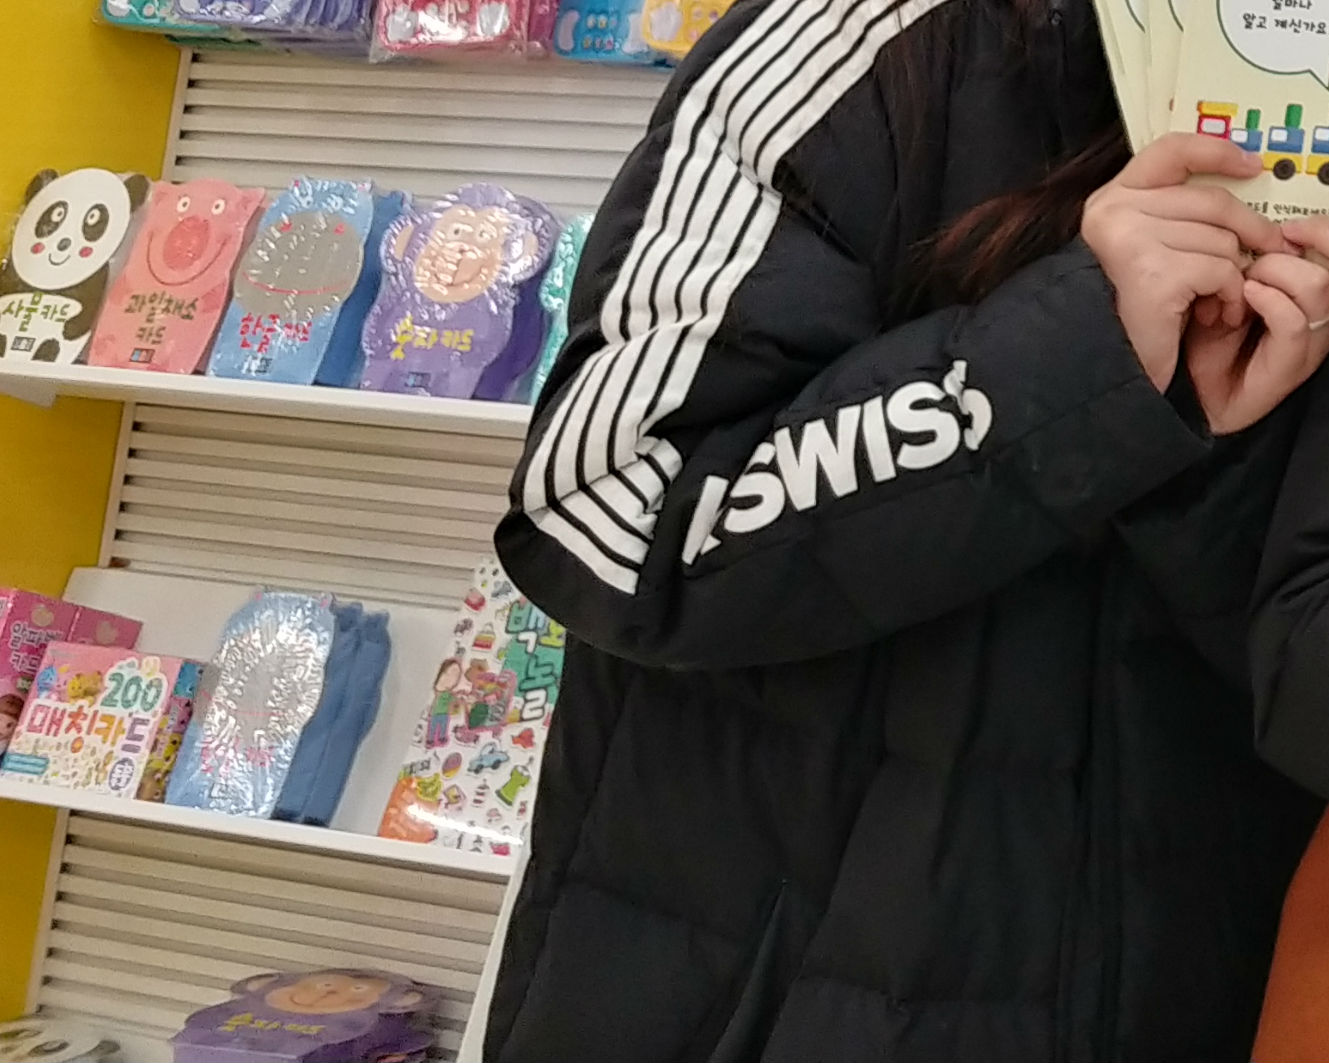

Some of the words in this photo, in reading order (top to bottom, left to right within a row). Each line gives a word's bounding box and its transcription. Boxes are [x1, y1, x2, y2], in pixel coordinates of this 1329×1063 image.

[1242, 12, 1268, 30] 알고
[2, 291, 71, 333] 사물카드
[124, 290, 200, 324] 과일채소
[136, 324, 167, 346] 카드
[100, 672, 163, 712] 200
